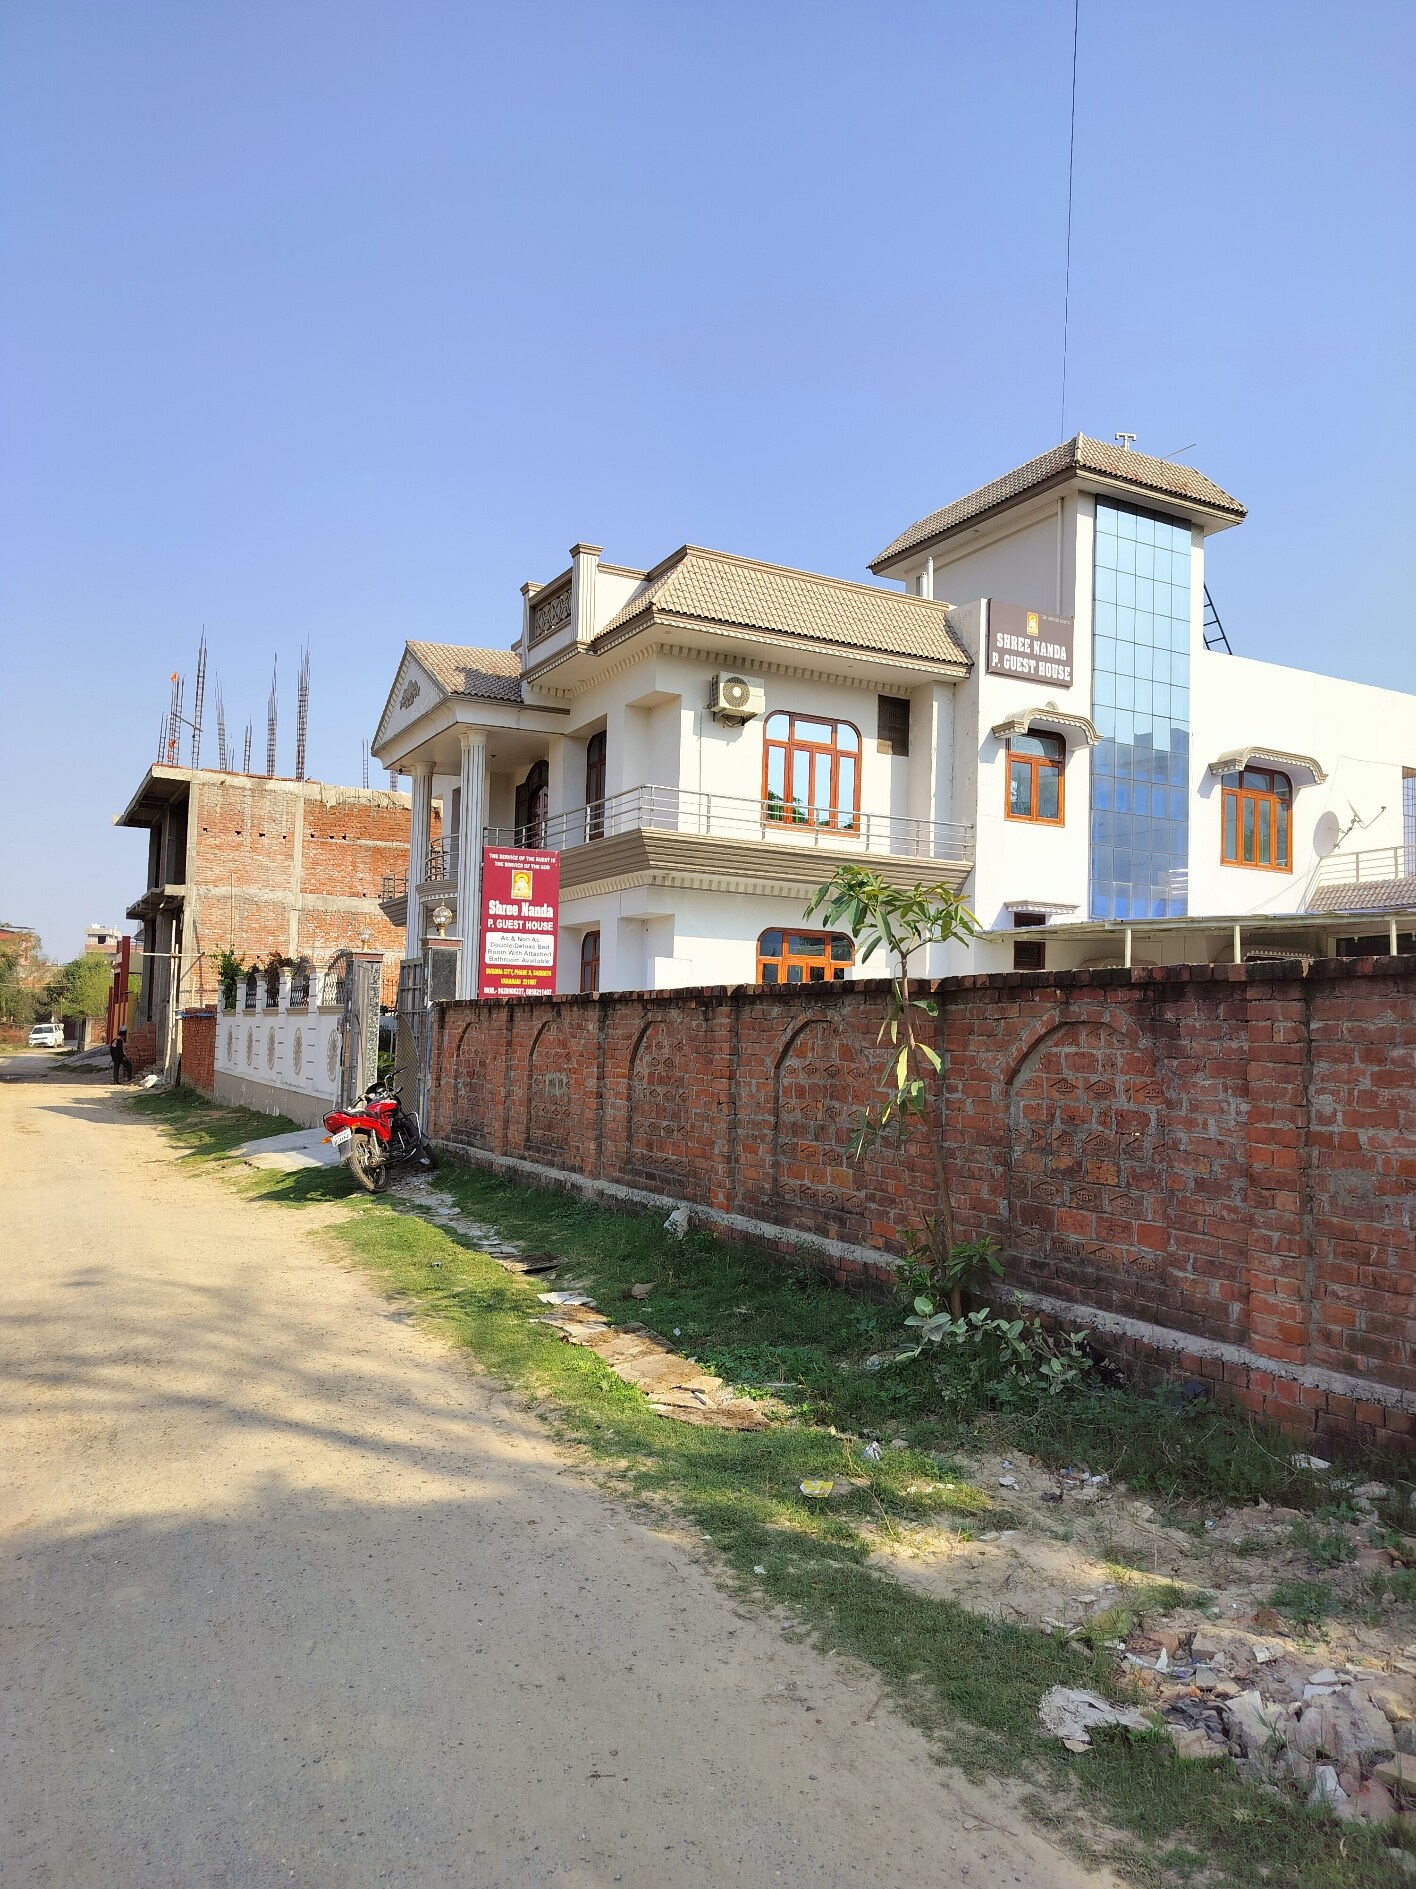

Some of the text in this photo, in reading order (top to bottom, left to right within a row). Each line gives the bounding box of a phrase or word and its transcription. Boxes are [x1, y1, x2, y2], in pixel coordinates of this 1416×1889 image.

[996, 632, 1067, 661] SHREE NANDA
[991, 651, 1071, 681] P. GUEST HOUSE
[488, 899, 554, 918] Shree Nanda
[487, 918, 554, 931] P. GUEST HOUSE
